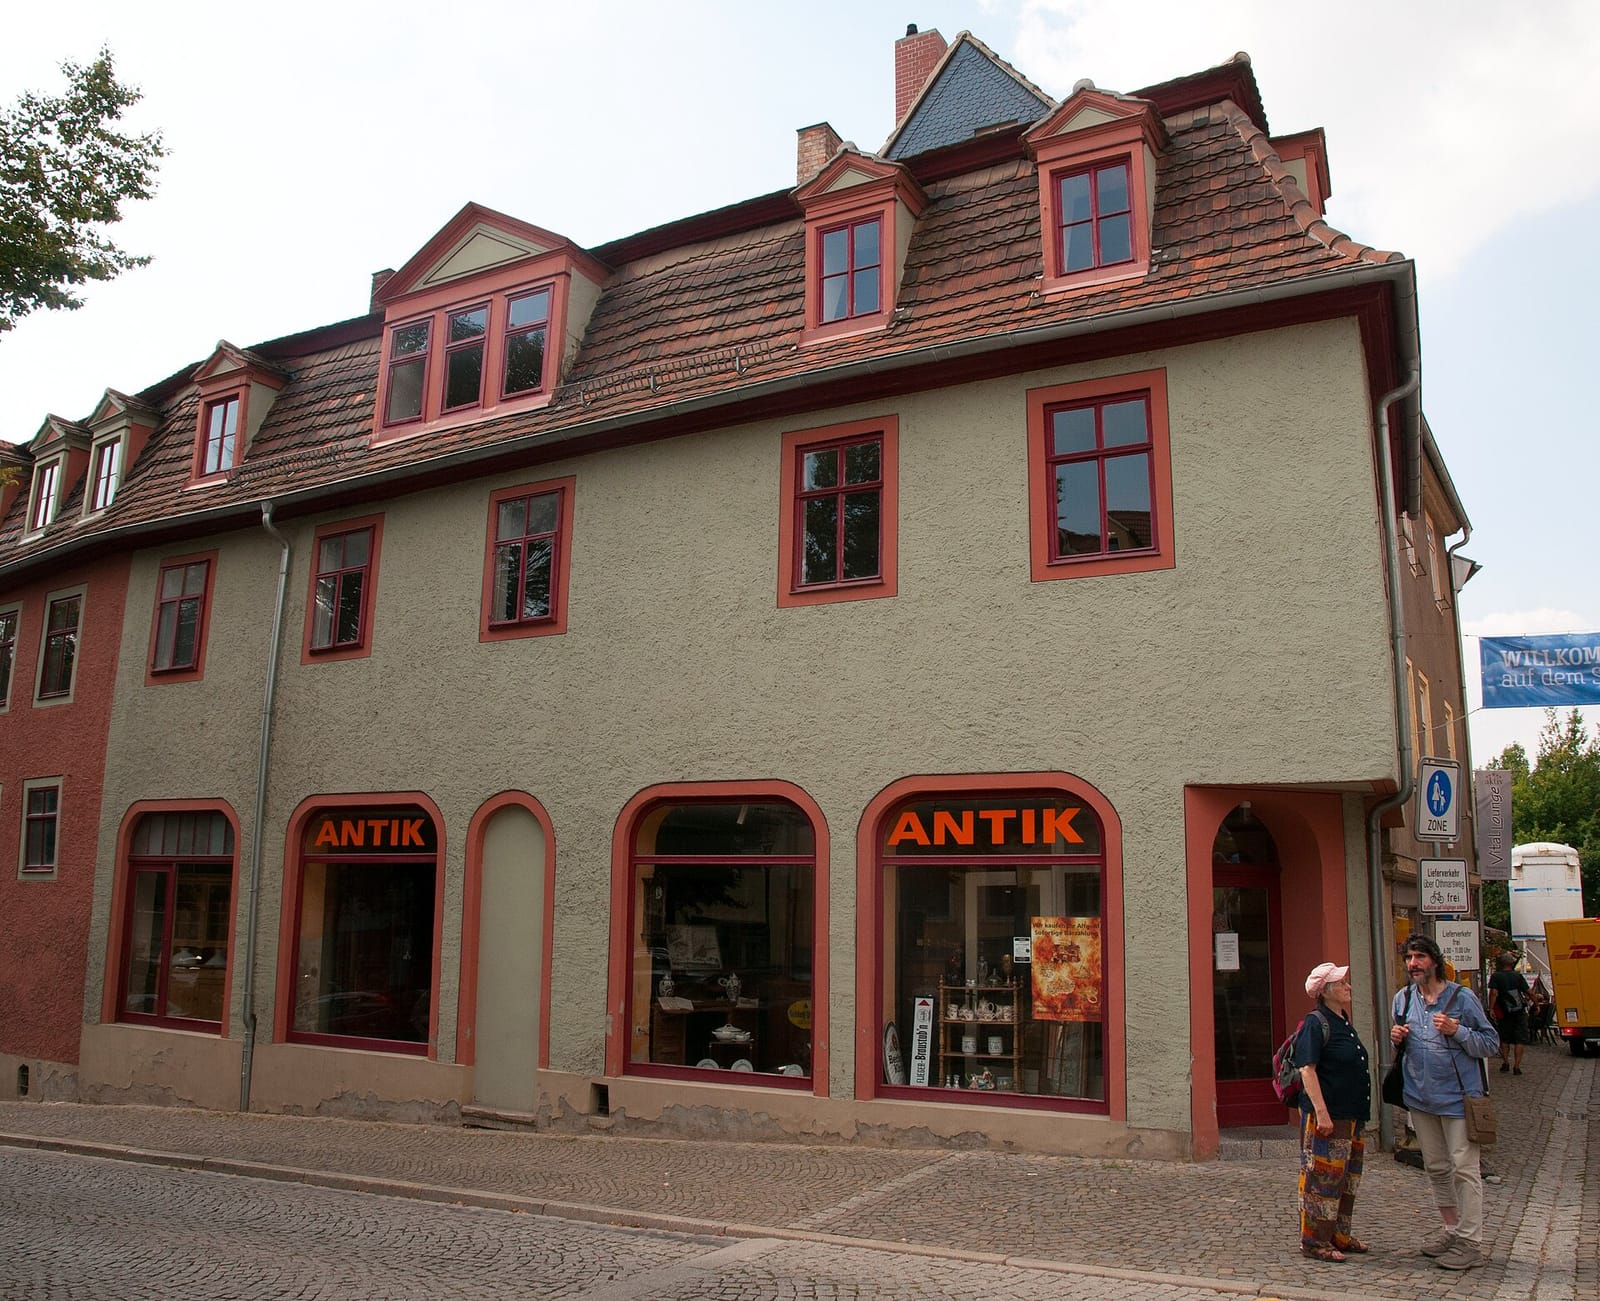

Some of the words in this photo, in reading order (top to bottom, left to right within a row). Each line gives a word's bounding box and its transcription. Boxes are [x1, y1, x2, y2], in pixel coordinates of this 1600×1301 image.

[1500, 646, 1600, 668] WILLKOM
[1501, 667, 1535, 688] auf
[1541, 667, 1586, 686] dem
[887, 807, 1085, 846] ANTIK
[1427, 819, 1448, 832] ZONE
[314, 819, 425, 847] ANTIK
[1427, 868, 1460, 878] Lieferverkehr
[1447, 892, 1460, 903] frei
[1442, 928, 1472, 938] Lieferverkehr
[1452, 938, 1460, 946] frei
